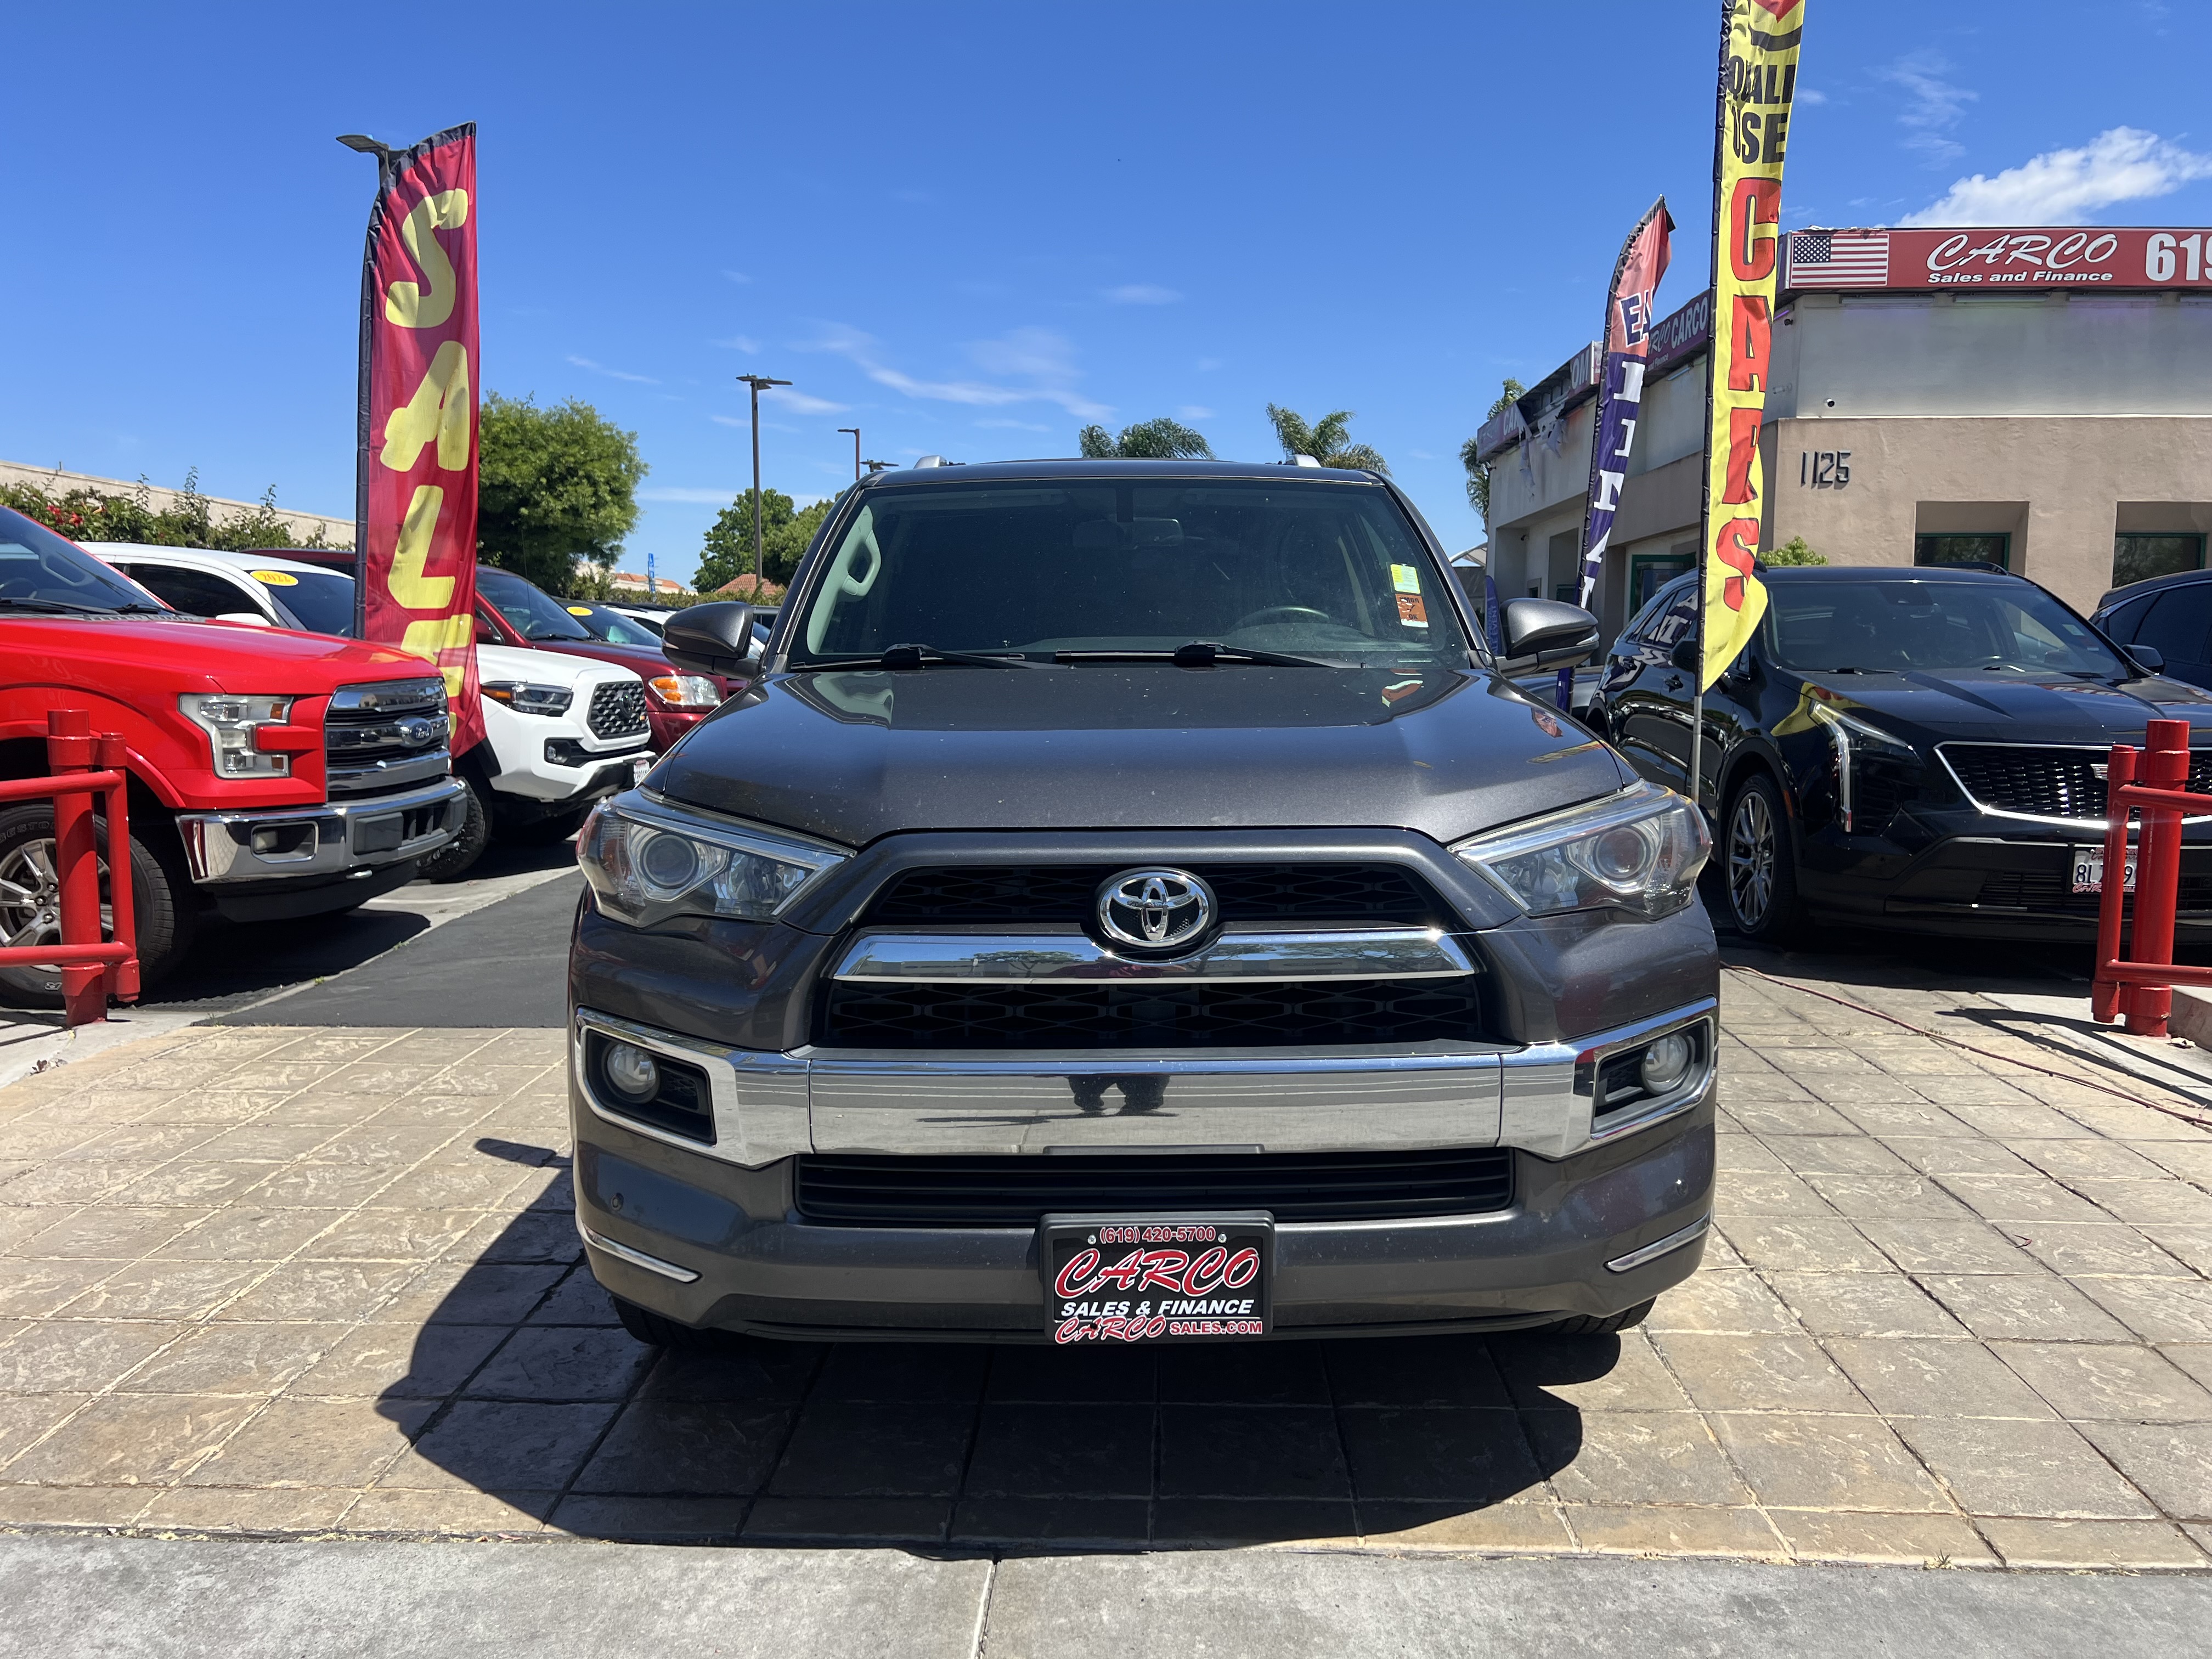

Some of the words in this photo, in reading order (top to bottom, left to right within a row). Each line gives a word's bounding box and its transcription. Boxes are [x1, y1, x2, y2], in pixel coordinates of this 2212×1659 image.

[1926, 232, 2118, 271] CARCO
[2145, 232, 2212, 281] 61
[1927, 272, 1983, 283] Sales
[1989, 271, 2028, 282] and
[2033, 270, 2114, 281] Finance
[1801, 450, 1852, 484] 1125
[1099, 1227, 1141, 1244] (619)
[1142, 1226, 1217, 1243] 420-5700
[1054, 1246, 1260, 1299] CARCO
[1061, 1300, 1130, 1317] SALES
[1135, 1300, 1151, 1316] &
[1158, 1299, 1255, 1315] FINANCE
[1054, 1314, 1166, 1345] CARCO
[1169, 1321, 1263, 1336] SALES.COM
